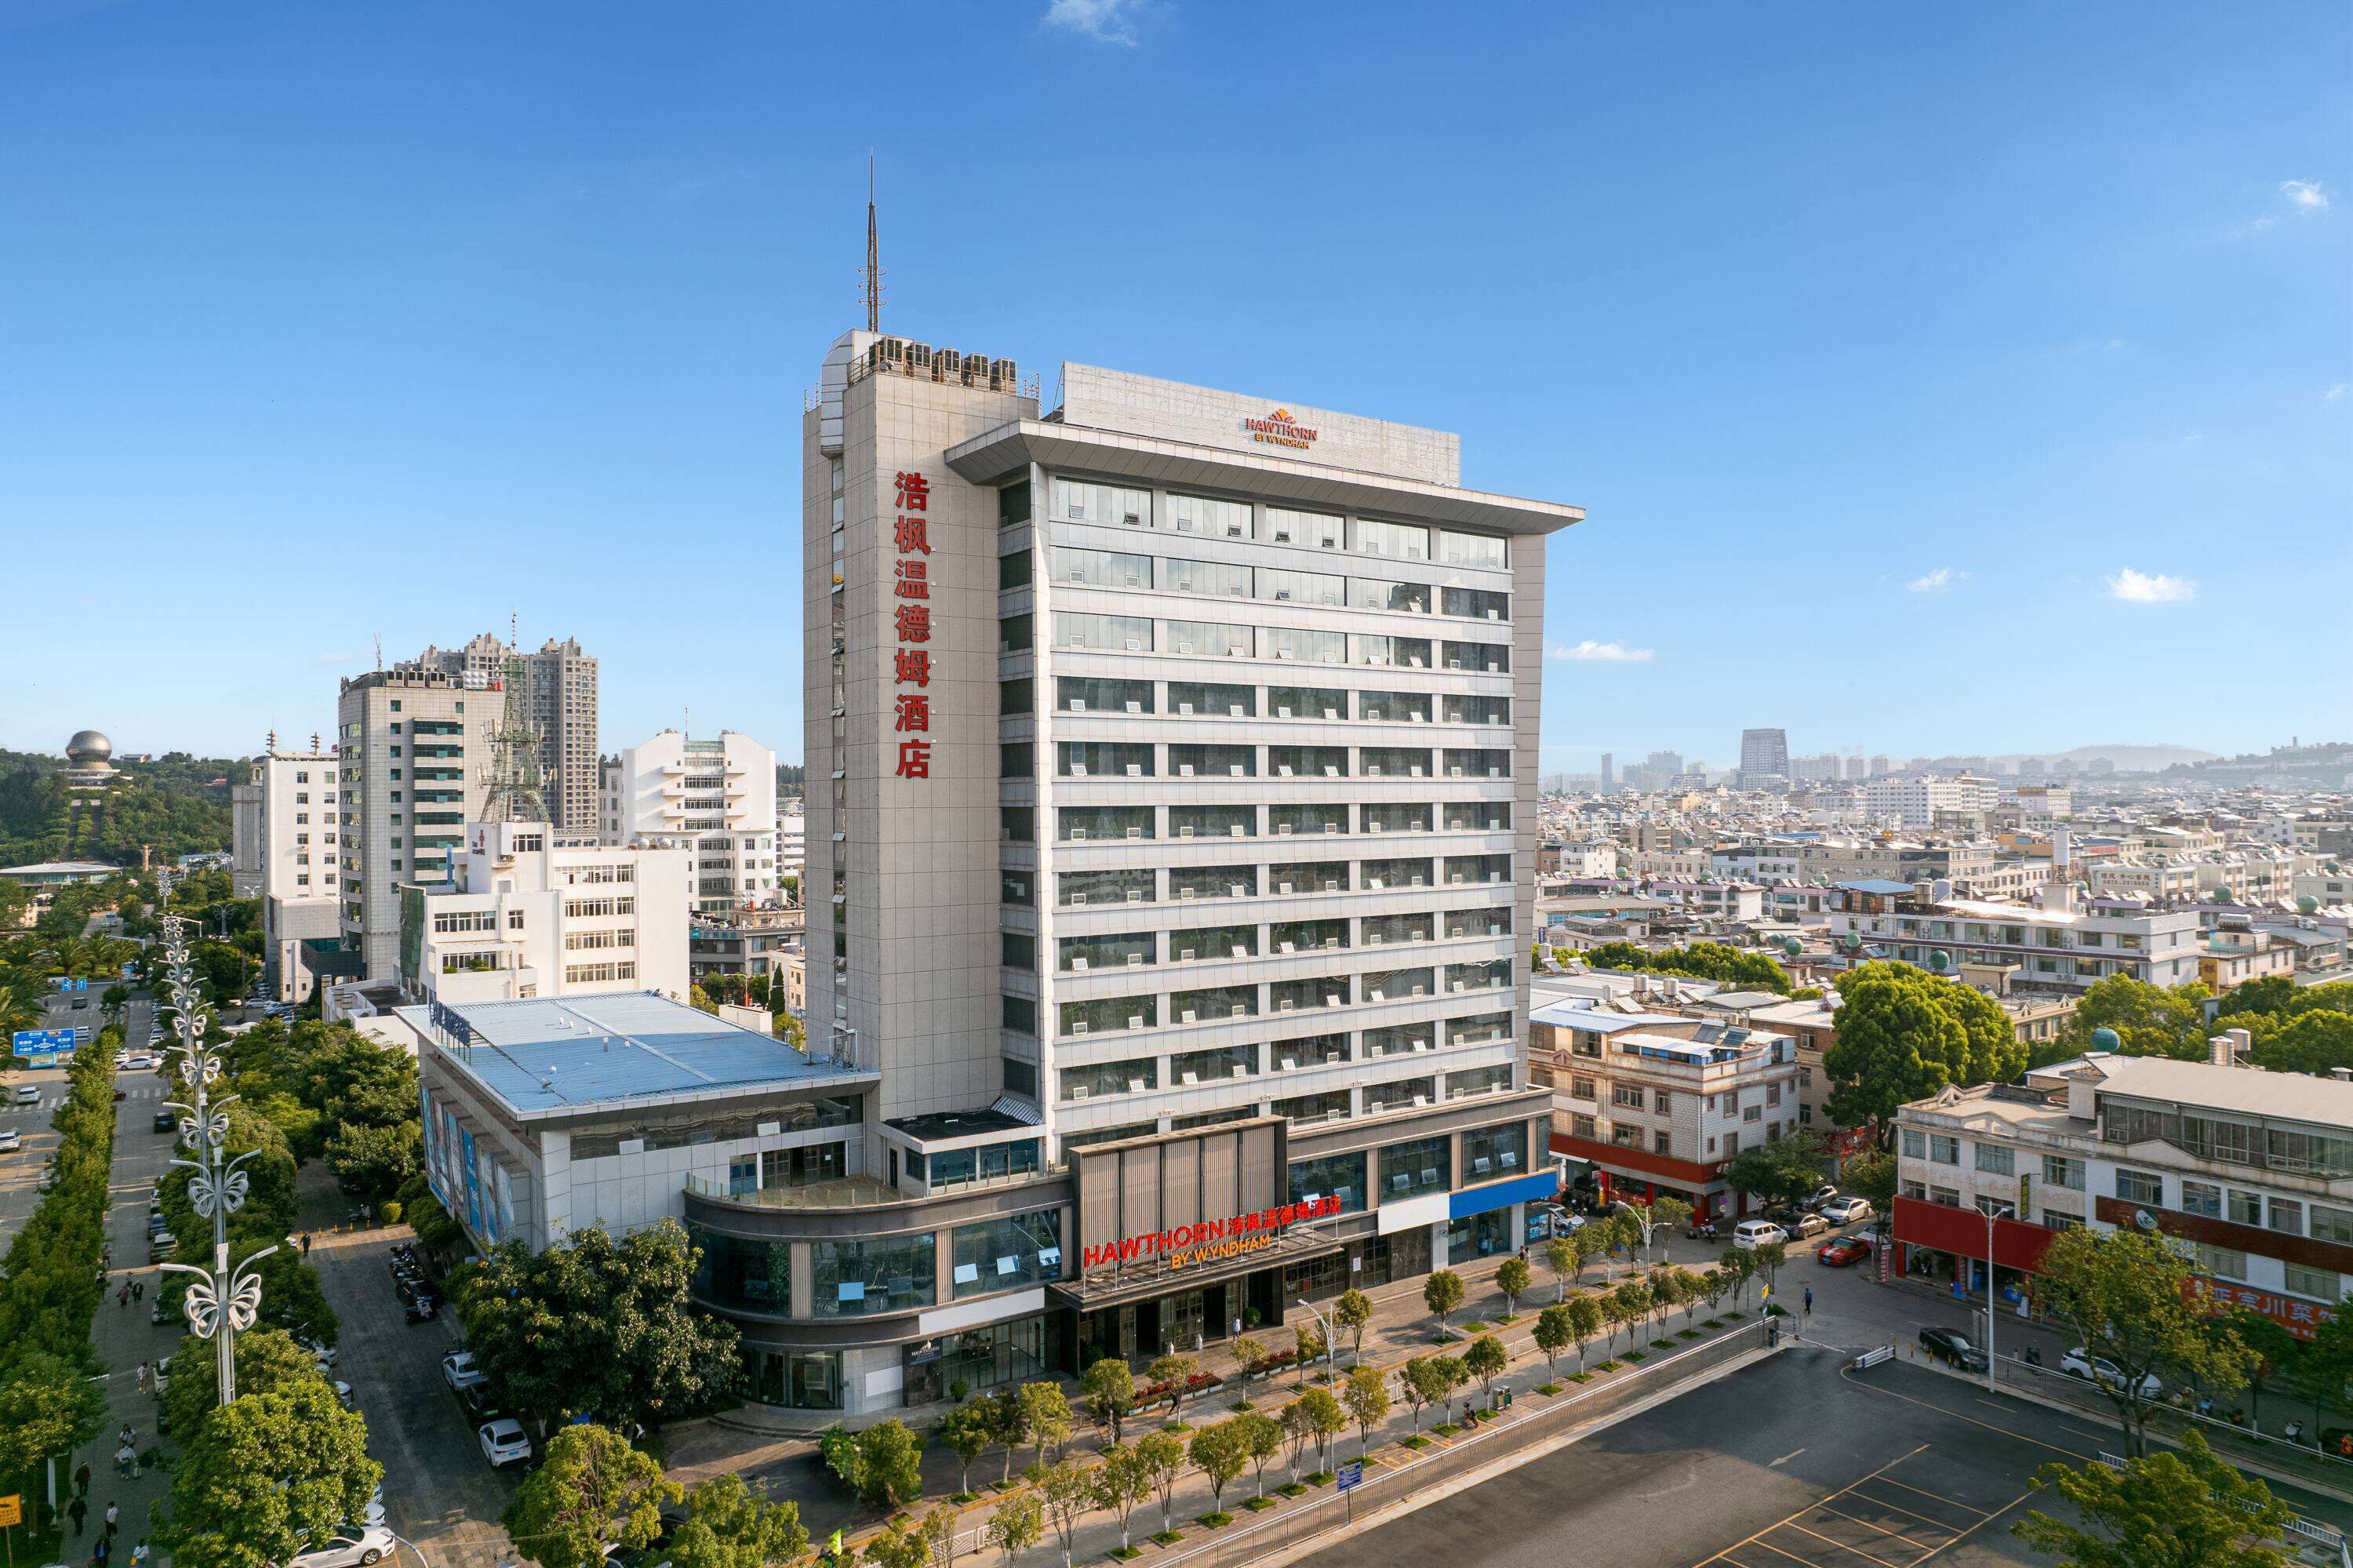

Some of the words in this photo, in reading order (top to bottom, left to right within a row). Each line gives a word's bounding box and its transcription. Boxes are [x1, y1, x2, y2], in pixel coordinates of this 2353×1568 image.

[1246, 418, 1318, 441] HAWTHORN
[1255, 433, 1267, 442] BY
[1267, 435, 1310, 449] WYNDHAM
[894, 471, 931, 779] 浩枫温德姆酒店
[1084, 1218, 1224, 1268] HAWTHORN
[1171, 1251, 1190, 1269] BY
[1193, 1234, 1271, 1264] WYNDHAM
